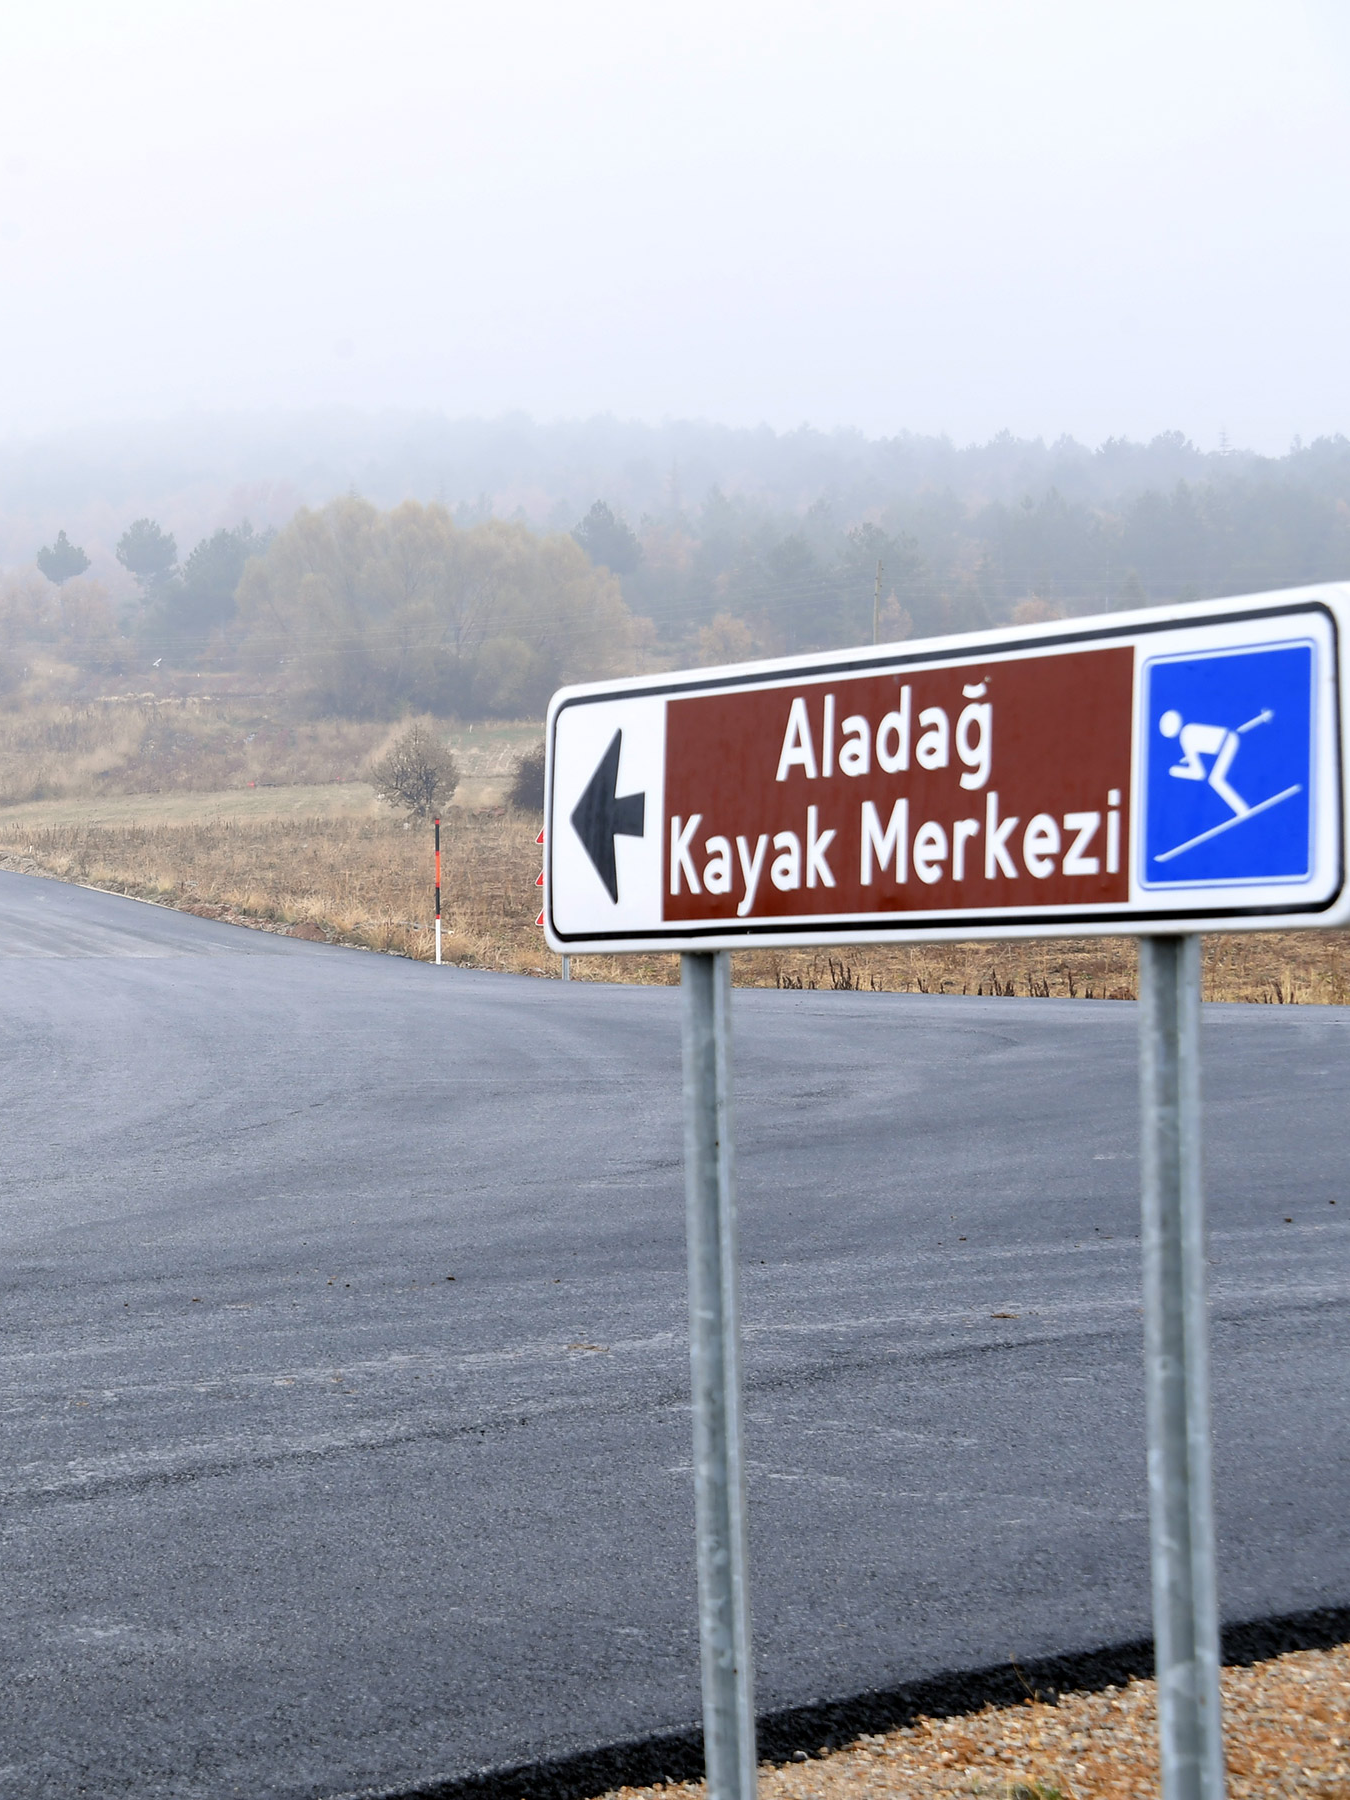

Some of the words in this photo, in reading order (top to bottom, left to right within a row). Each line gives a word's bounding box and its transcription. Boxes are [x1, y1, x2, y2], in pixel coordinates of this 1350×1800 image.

[775, 682, 993, 791] Aladağ
[670, 804, 837, 917] Kayak
[860, 788, 1121, 886] Merkezi
